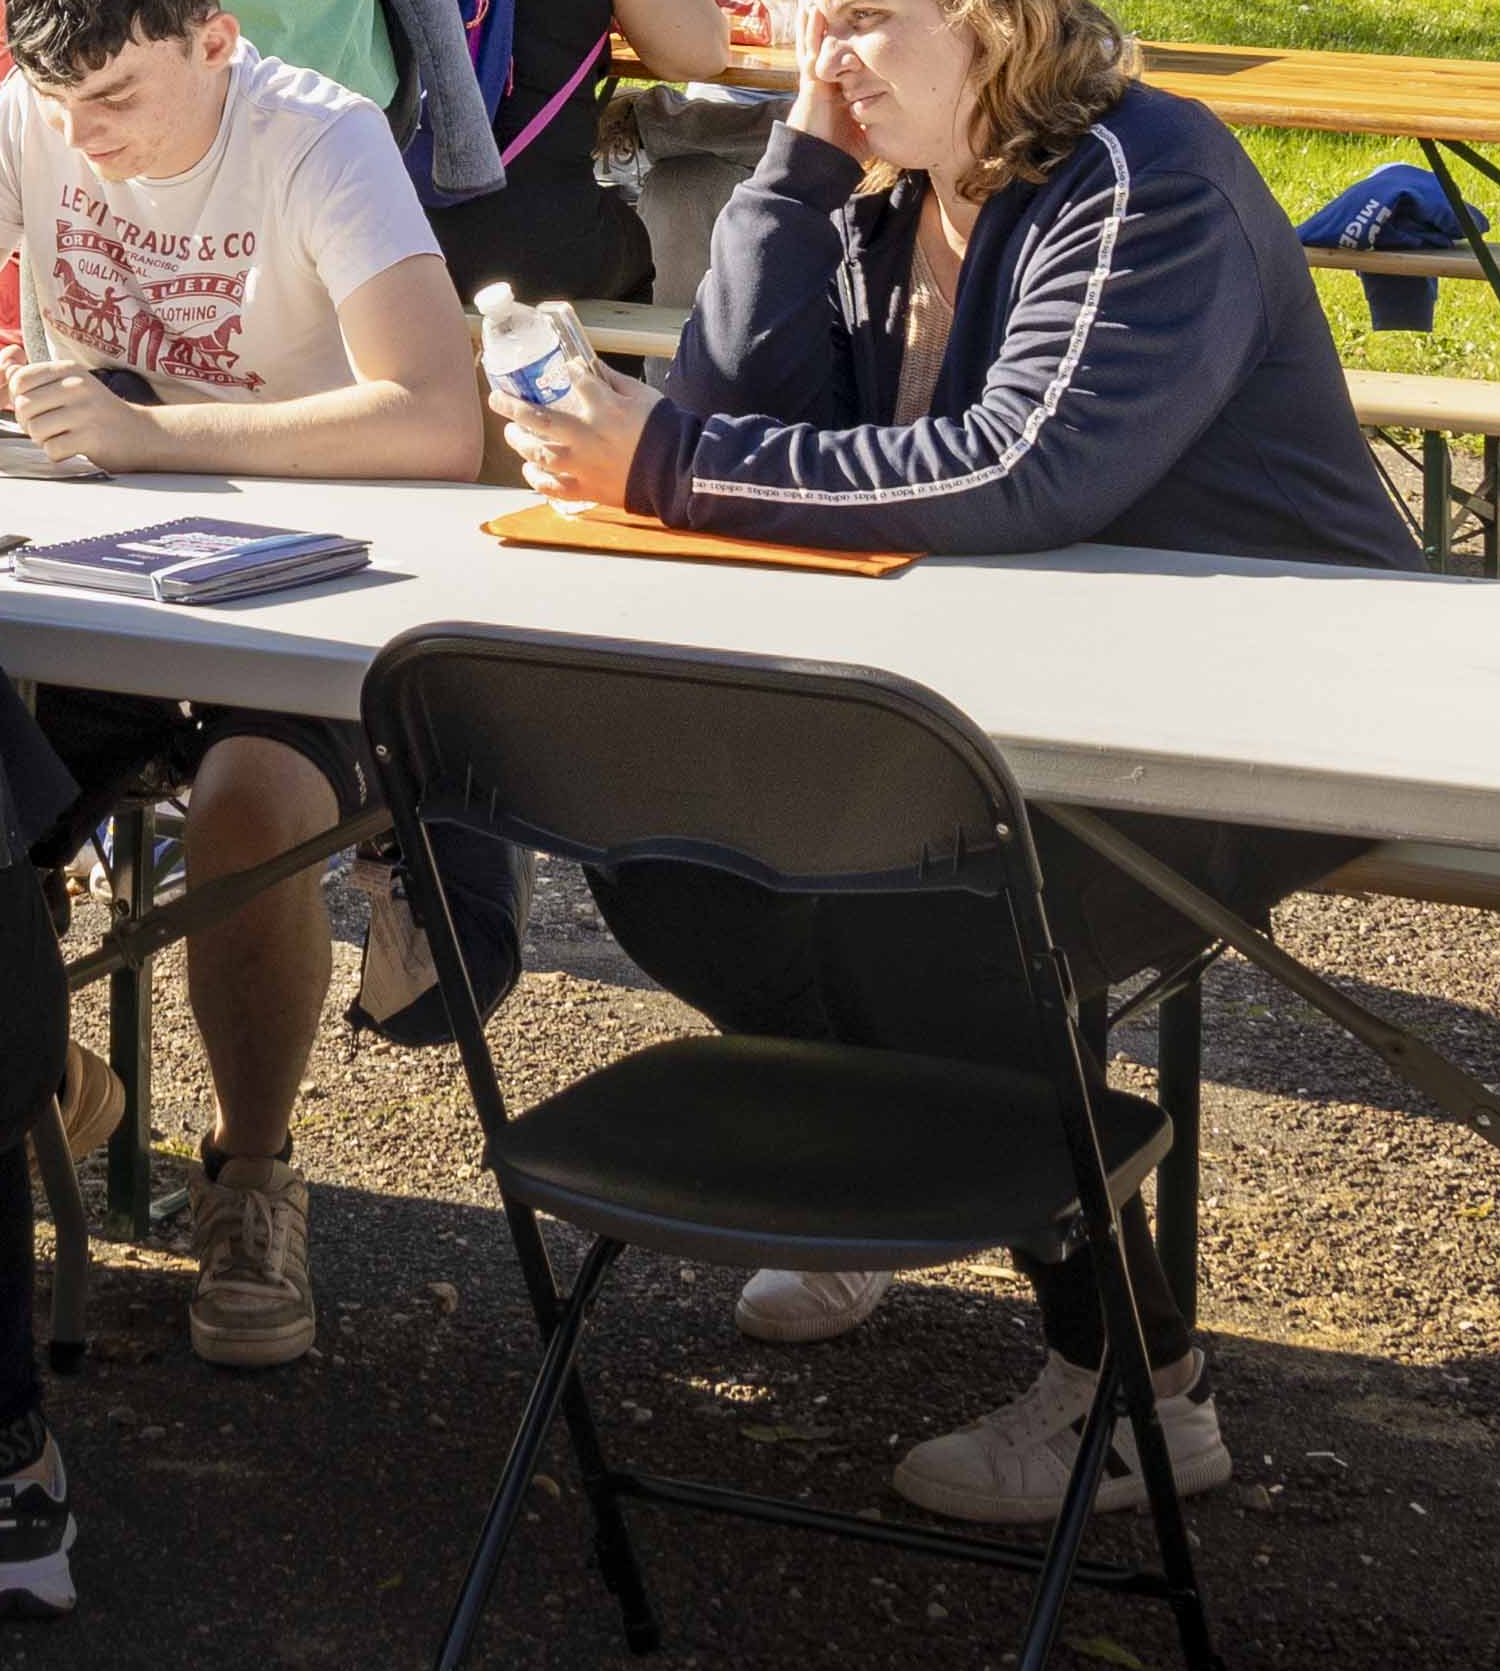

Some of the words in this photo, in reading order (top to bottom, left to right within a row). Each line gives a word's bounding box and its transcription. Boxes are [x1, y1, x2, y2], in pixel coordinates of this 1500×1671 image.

[60, 184, 109, 227] LEVI
[197, 235, 216, 261] &
[223, 231, 256, 259] CO
[154, 304, 217, 323] CLOTHING
